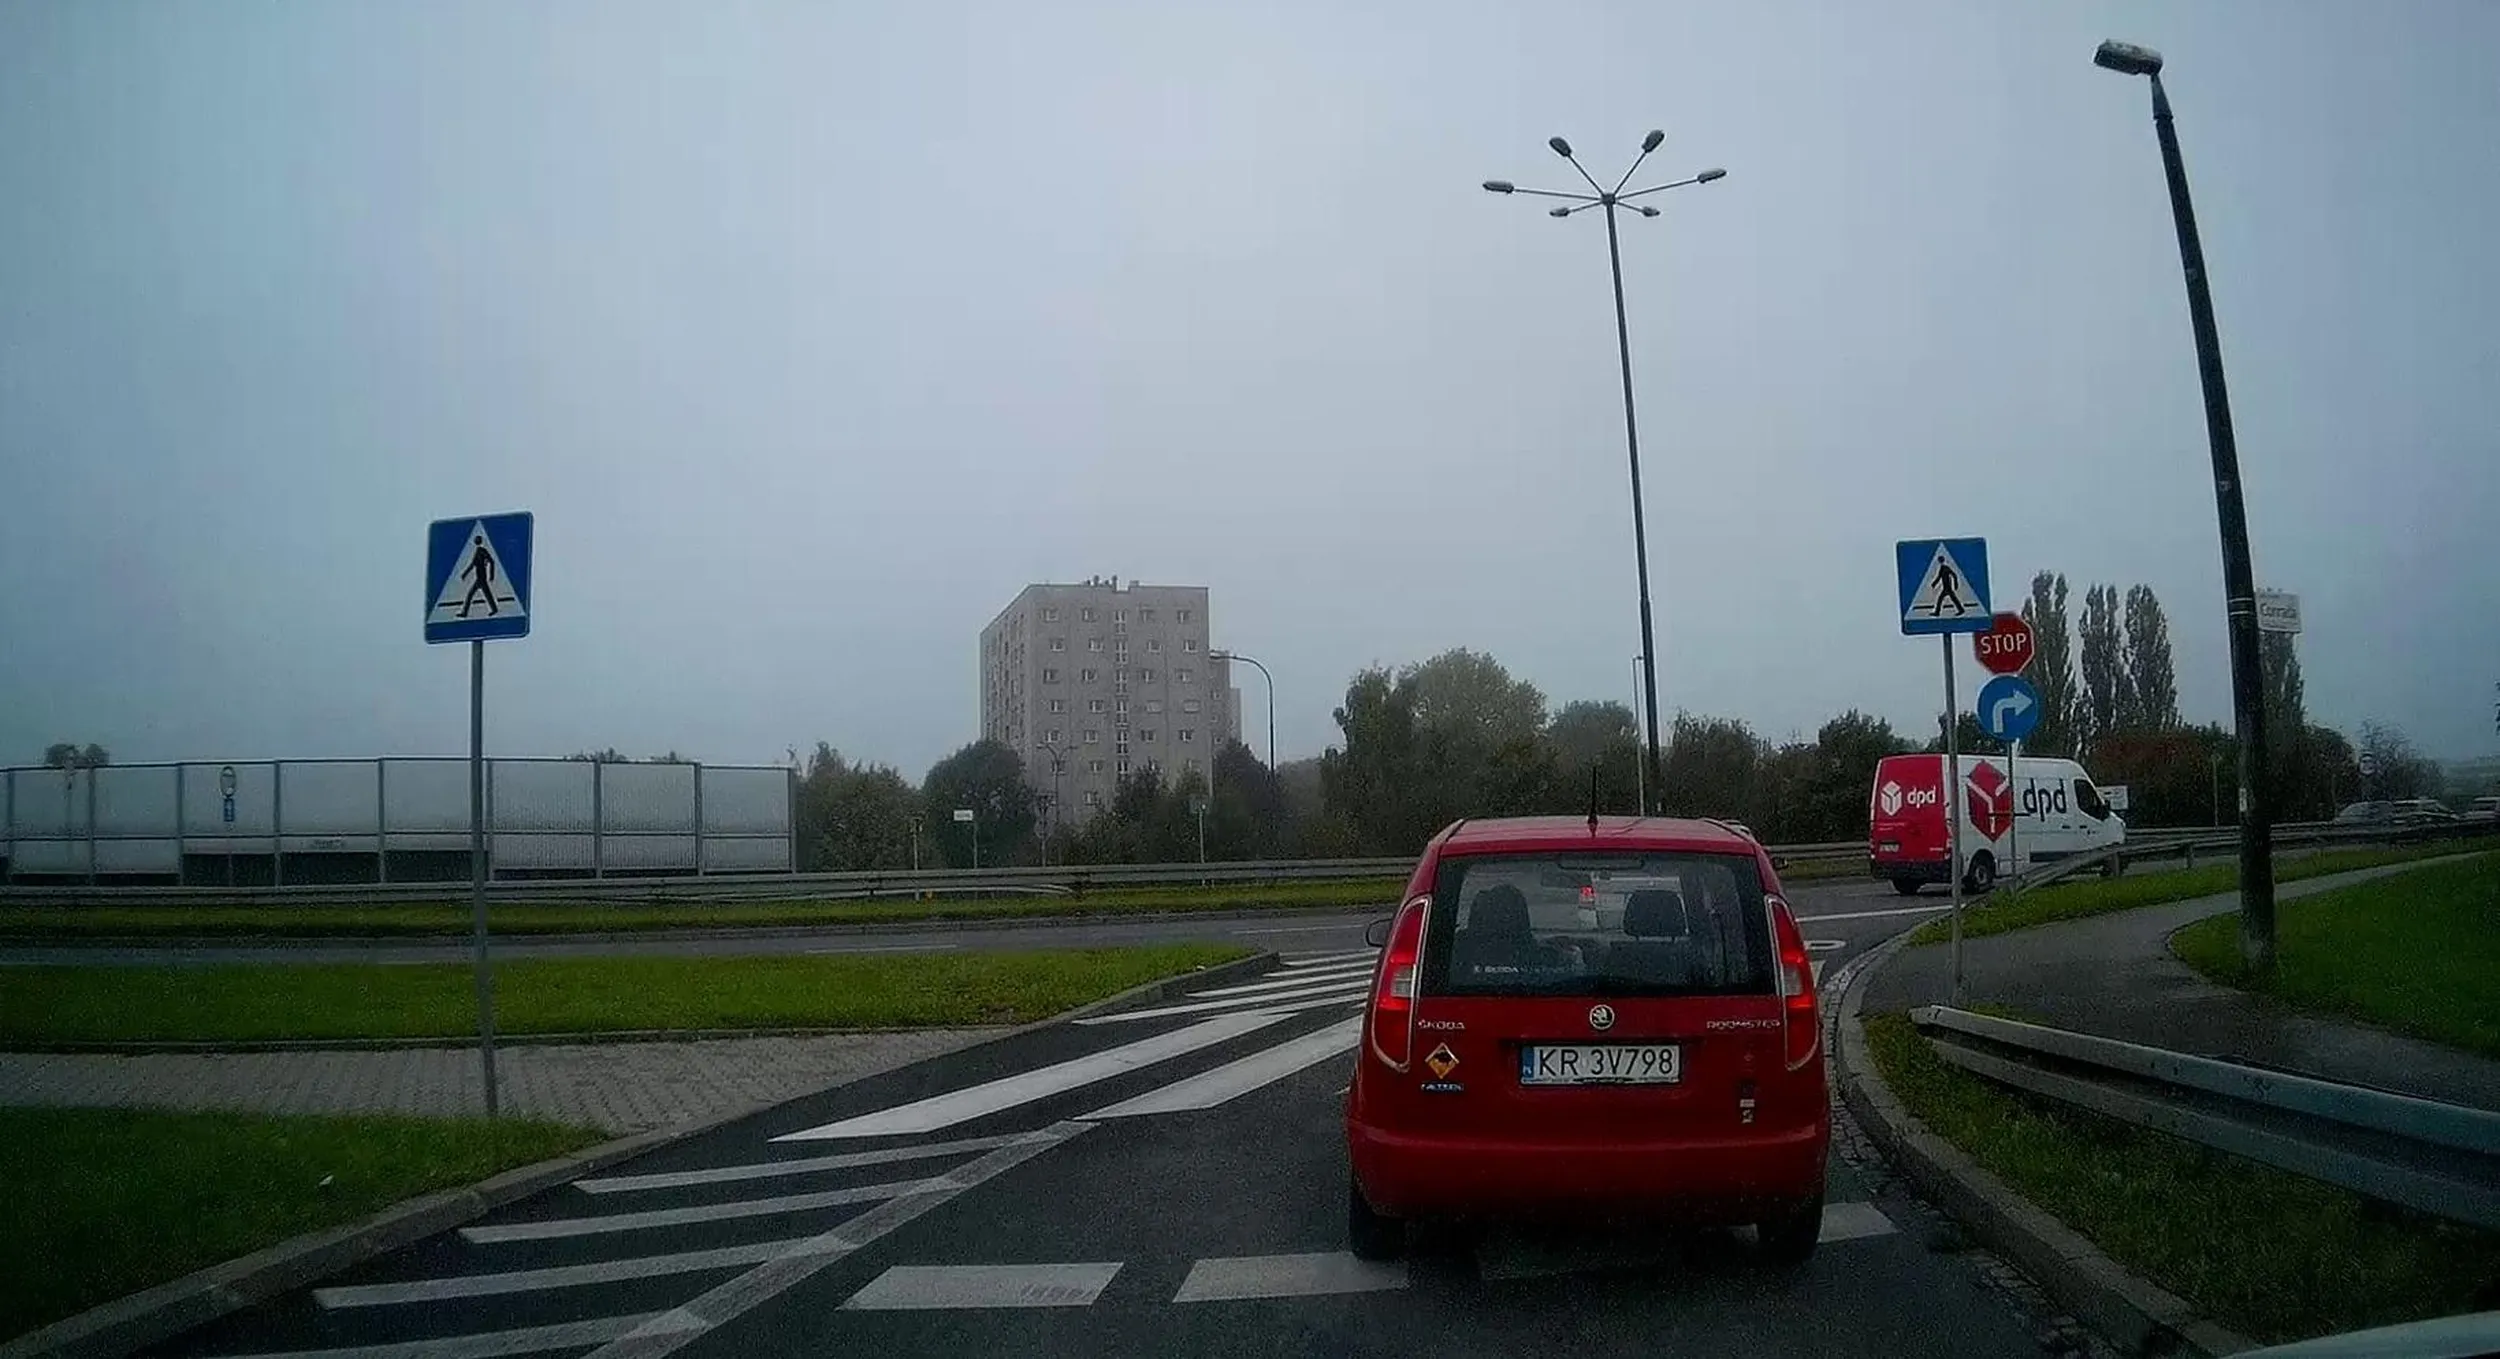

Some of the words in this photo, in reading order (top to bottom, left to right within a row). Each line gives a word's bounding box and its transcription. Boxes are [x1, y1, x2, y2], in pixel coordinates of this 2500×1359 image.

[1980, 633, 2027, 654] STOP
[1907, 785, 1936, 809] dpd
[2023, 778, 2067, 822] dpd
[1706, 1019, 1780, 1030] ROOMSTER
[1539, 1049, 1578, 1076] KR
[1590, 1049, 1673, 1076] 3V798
